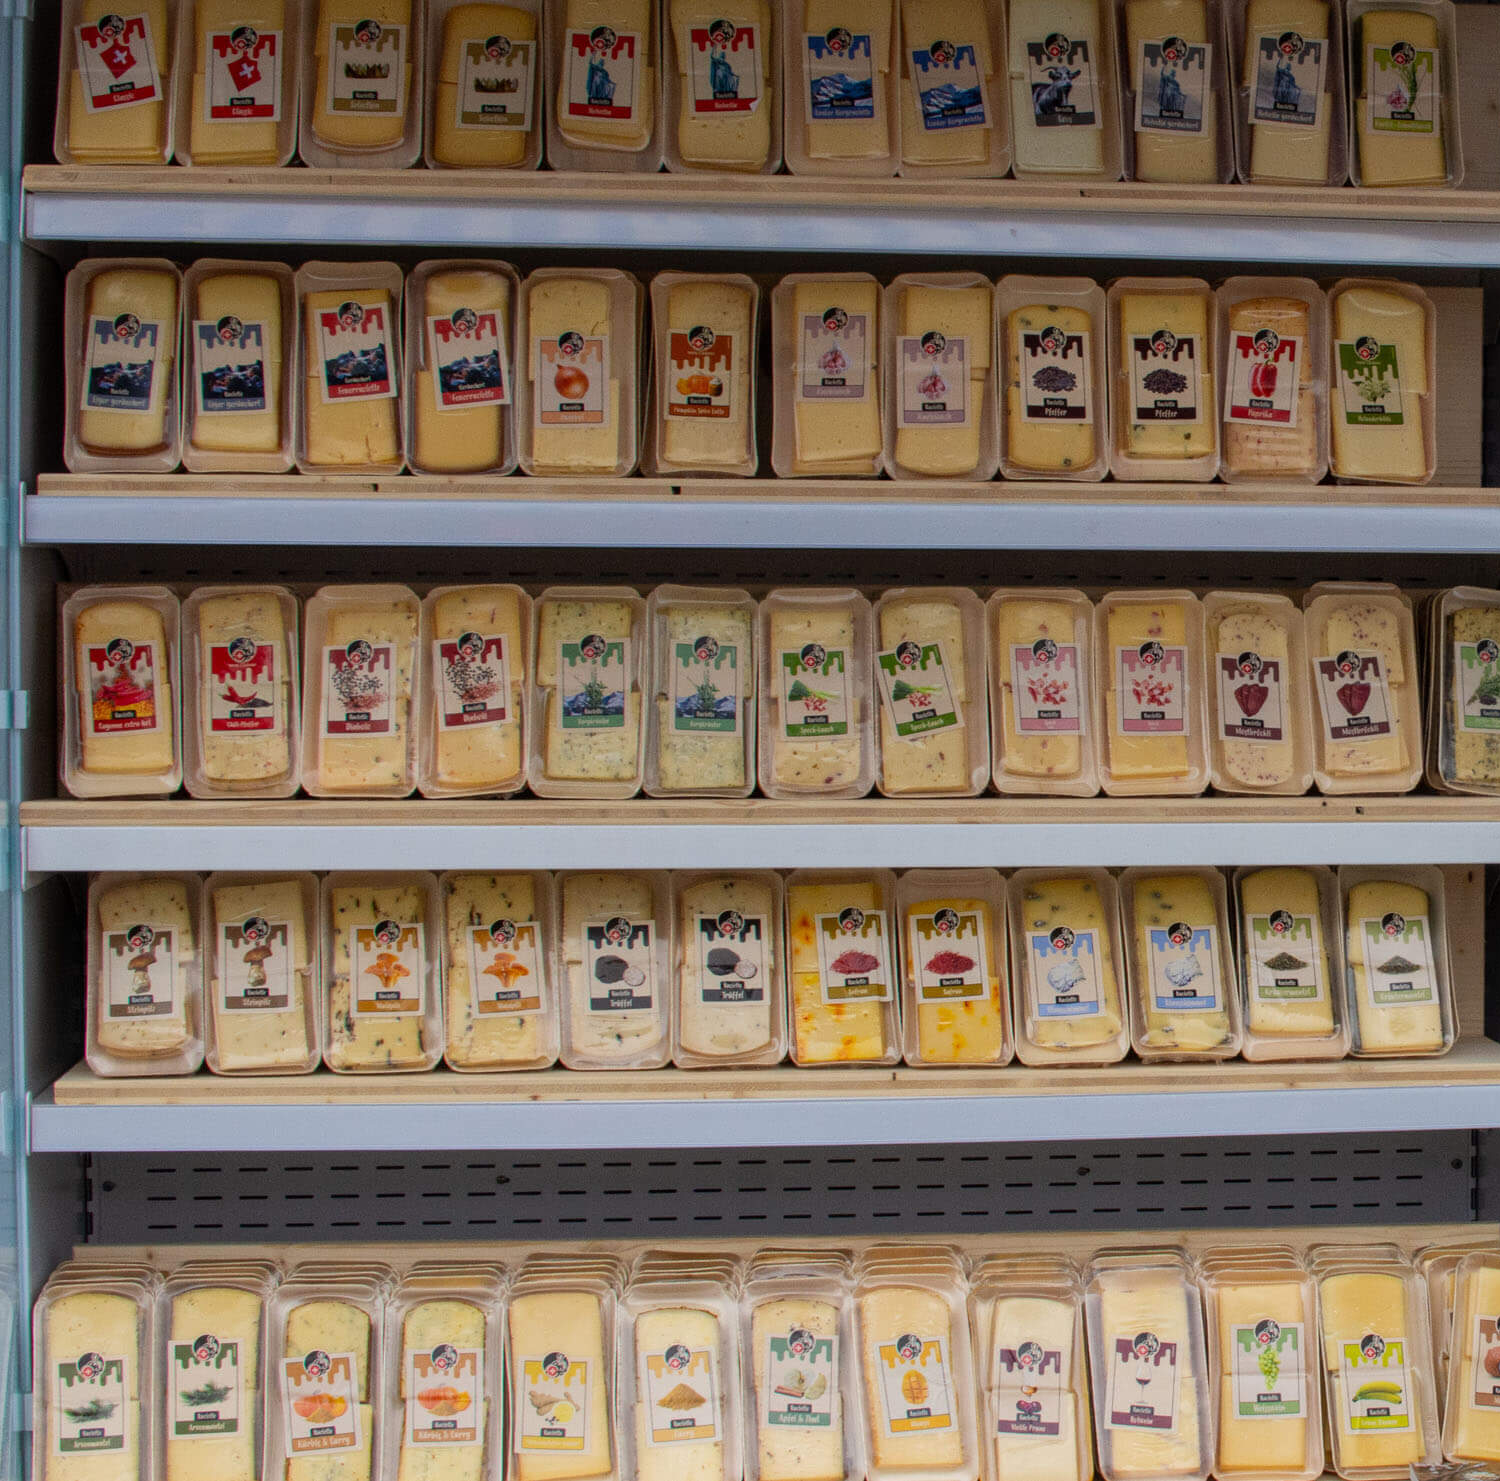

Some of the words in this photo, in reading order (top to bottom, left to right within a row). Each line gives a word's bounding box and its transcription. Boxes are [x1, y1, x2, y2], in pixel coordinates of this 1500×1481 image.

[1044, 407, 1068, 416] Pfeffer
[1155, 409, 1178, 418] Pfeffer
[721, 990, 744, 1000] Trüffel
[610, 998, 633, 1008] Trüffel
